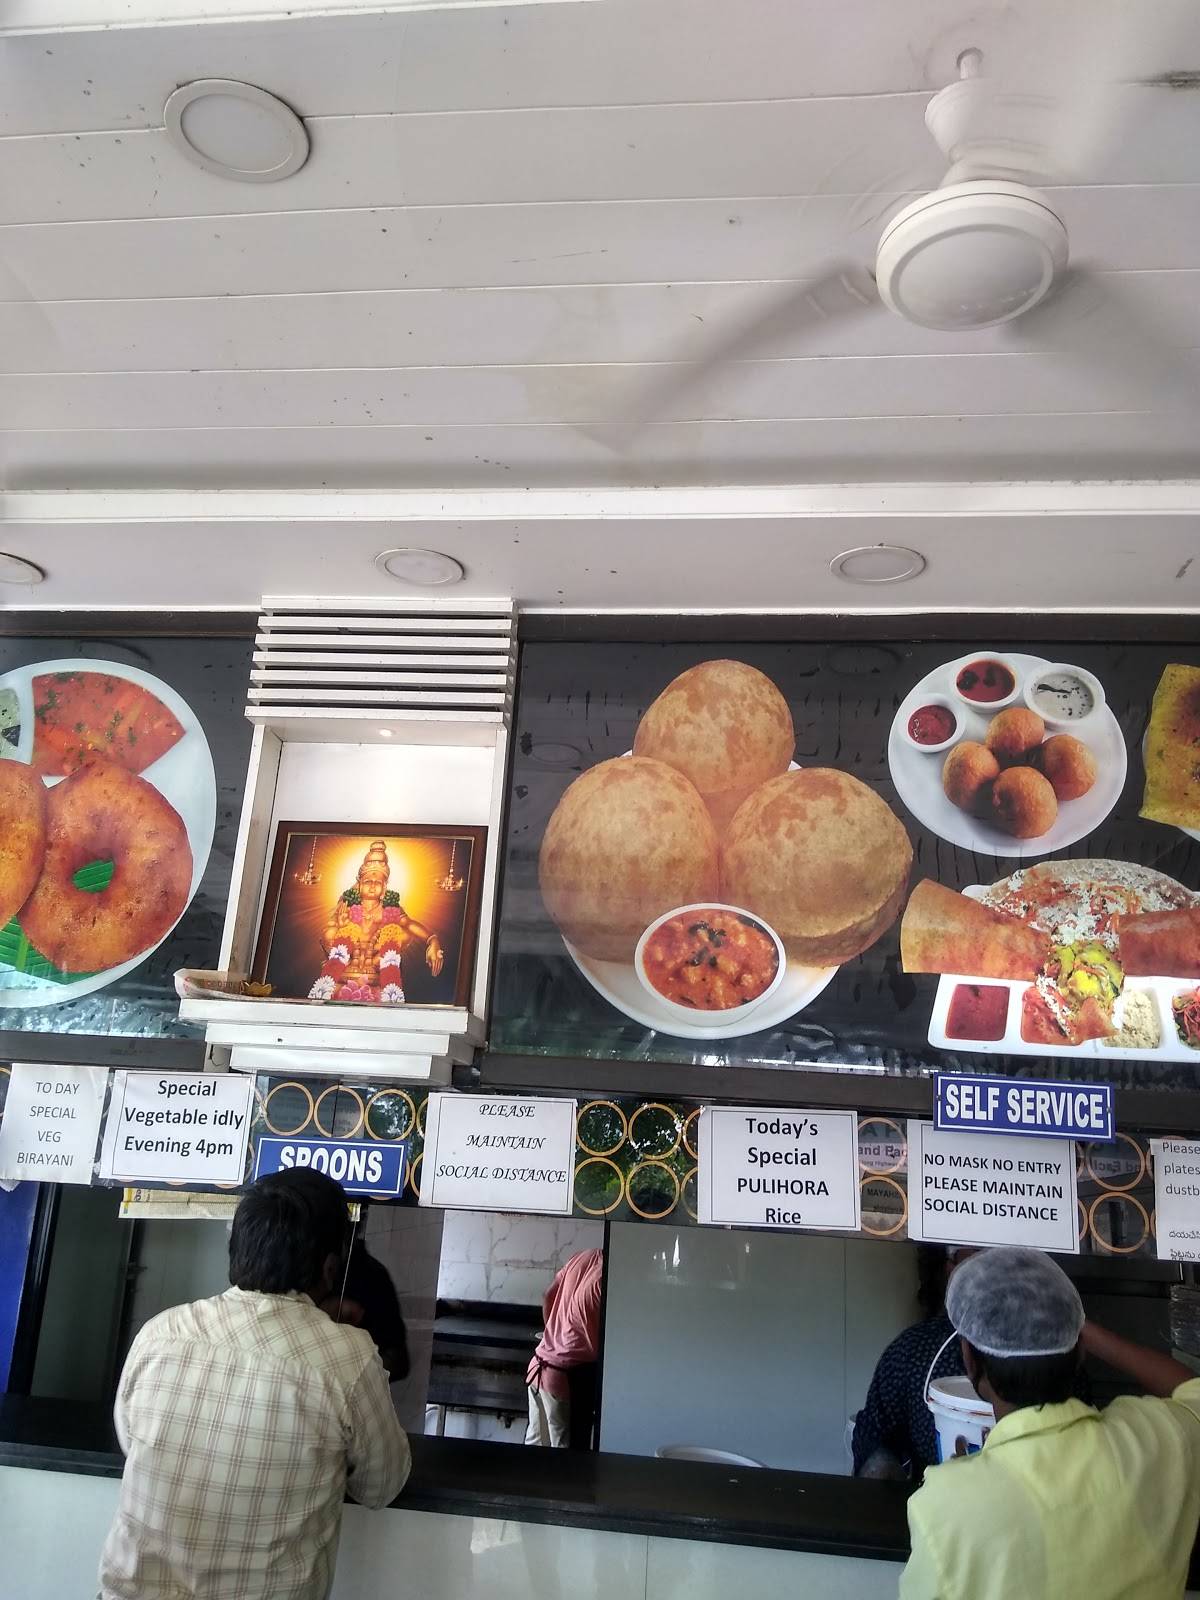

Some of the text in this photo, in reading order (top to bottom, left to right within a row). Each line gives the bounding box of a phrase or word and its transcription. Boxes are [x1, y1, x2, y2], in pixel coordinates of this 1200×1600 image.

[36, 1081, 80, 1095] TO DAY
[157, 1079, 217, 1098] Special
[29, 1105, 77, 1119] SPECIAL
[479, 1103, 536, 1118] PLEASE
[945, 1083, 1104, 1129] SELF SERVICE
[124, 1107, 244, 1130] Vegetable idly
[745, 1117, 818, 1139] Today's
[37, 1130, 62, 1143] VEG
[466, 1134, 547, 1150] MAINTAIN
[124, 1135, 233, 1158] Evening 4pm
[1162, 1141, 1200, 1154] Please
[17, 1152, 74, 1167] BIRAYANI
[278, 1145, 383, 1183] SPOONS
[747, 1146, 817, 1168] Special
[924, 1153, 1062, 1175] NO MASK NO ENTRY
[436, 1164, 567, 1183] SOCIAL DISTANCE
[1164, 1162, 1200, 1175] plates
[737, 1177, 829, 1196] PULIHORA
[924, 1176, 1063, 1199] PLEASE MAINTAIN
[765, 1207, 802, 1224] Rice
[924, 1198, 978, 1215] SOCIAL
[983, 1203, 1058, 1222] DISTANCE
